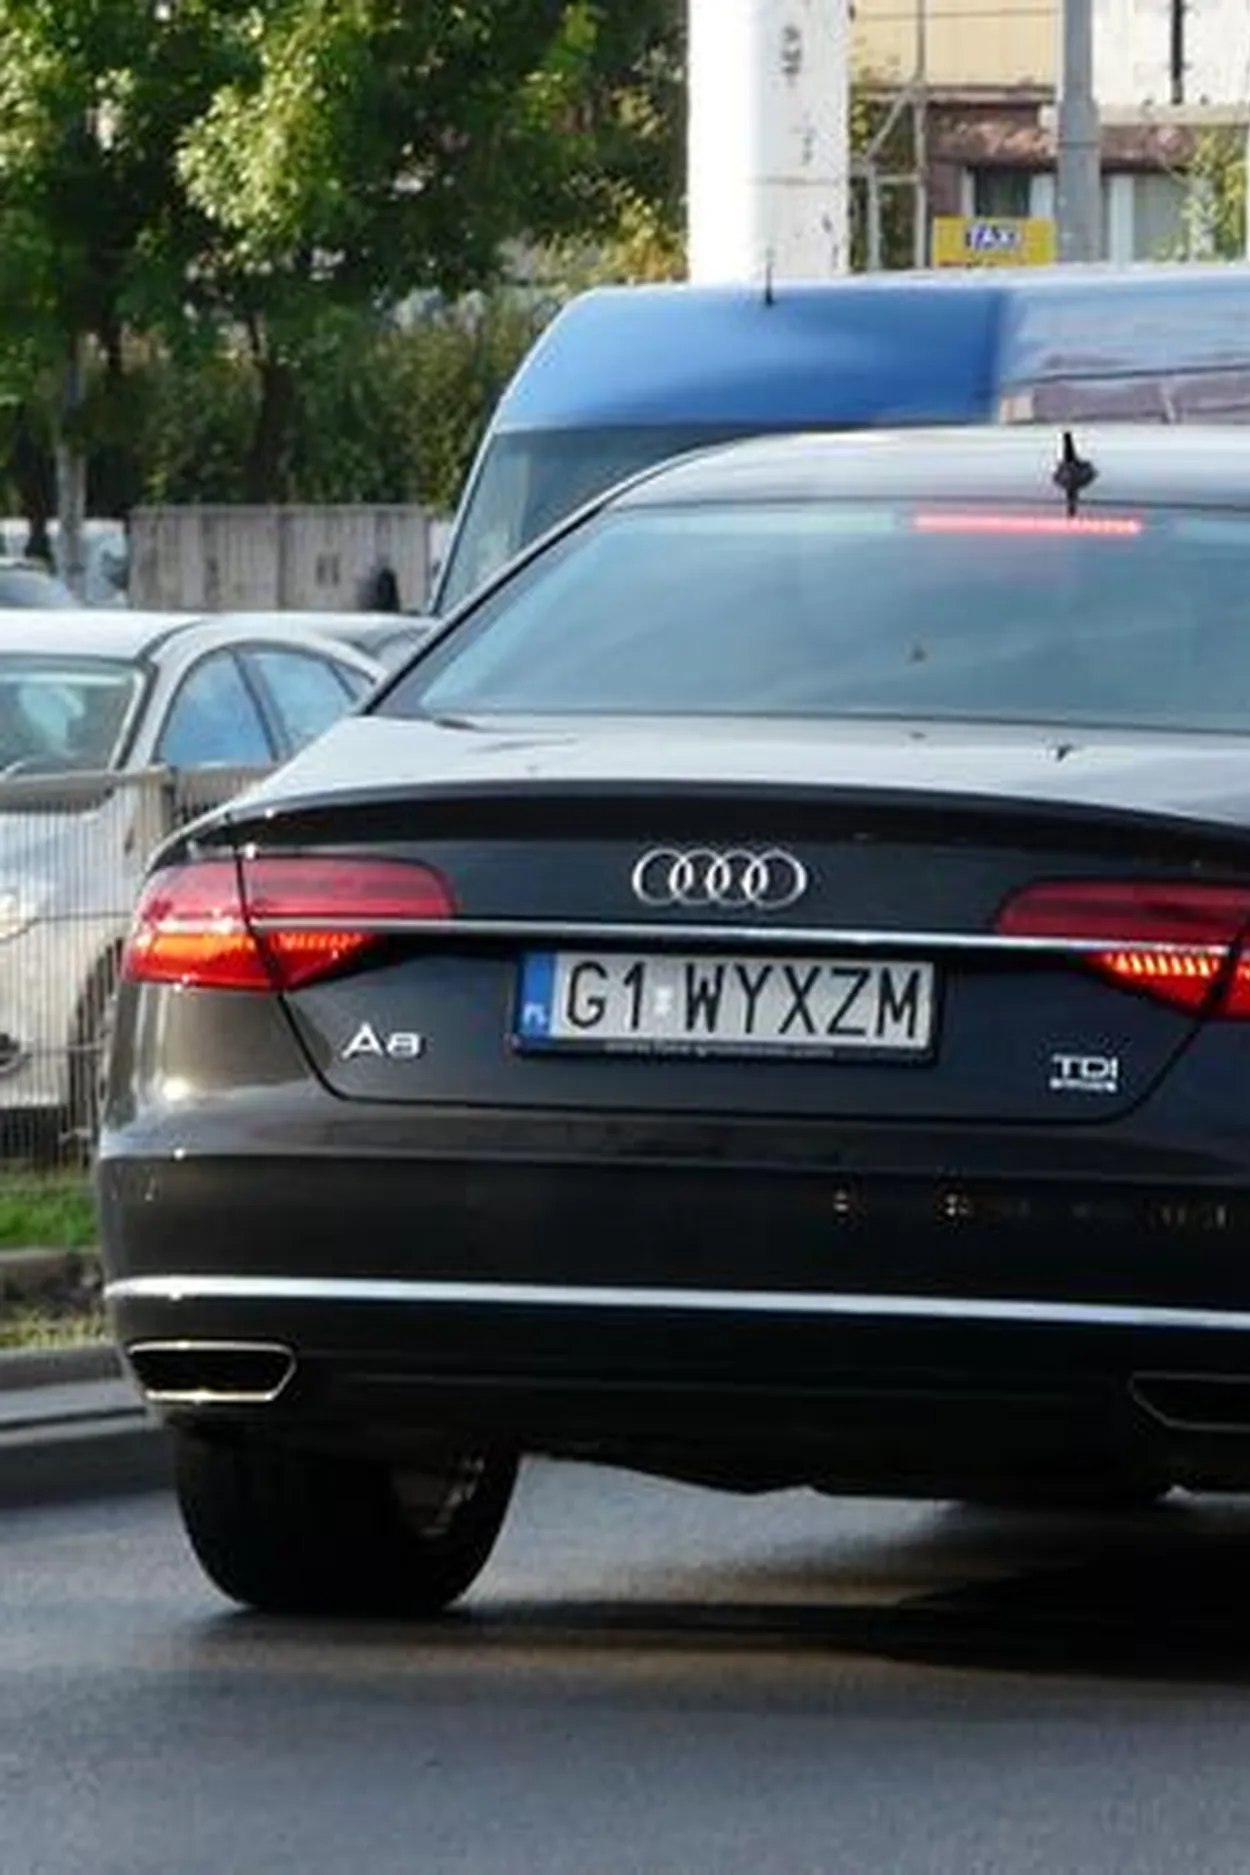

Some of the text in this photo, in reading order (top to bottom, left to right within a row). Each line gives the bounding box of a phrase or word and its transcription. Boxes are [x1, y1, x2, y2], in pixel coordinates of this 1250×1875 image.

[566, 961, 921, 1039] G1 WYXZM
[341, 1021, 420, 1058] A8
[1051, 1053, 1118, 1079] TDI
